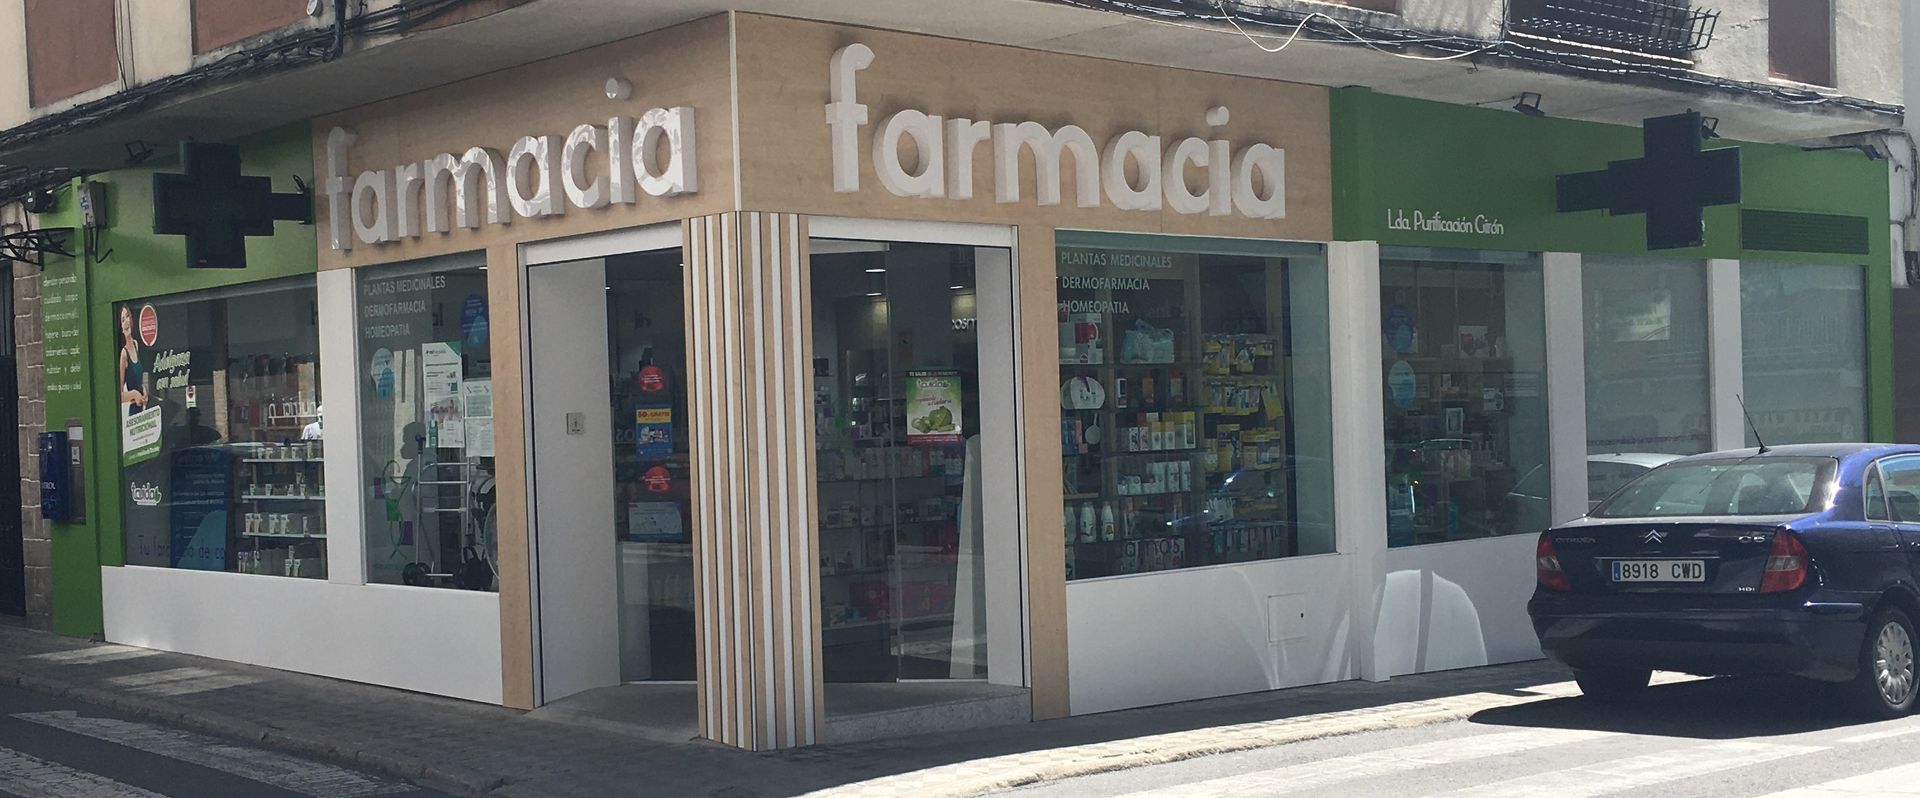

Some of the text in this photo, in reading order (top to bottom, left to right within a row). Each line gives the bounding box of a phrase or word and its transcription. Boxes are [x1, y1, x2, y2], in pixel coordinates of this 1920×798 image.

[824, 43, 1286, 219] farmacia
[325, 77, 697, 250] farmacia
[1413, 209, 1473, 233] Purificación
[1474, 214, 1504, 235] Girón
[1061, 252, 1172, 269] PLANTAS MEDICINALES
[363, 275, 446, 296] PLANTAS MEDICINALES
[1061, 276, 1150, 291] DERMOFARMACIA
[363, 299, 426, 318] DERMOFARMACIA
[1062, 299, 1130, 314] HOMEOPATIA
[365, 322, 411, 339] HOMEOPATIA
[1622, 562, 1702, 580] 8918 CWD
